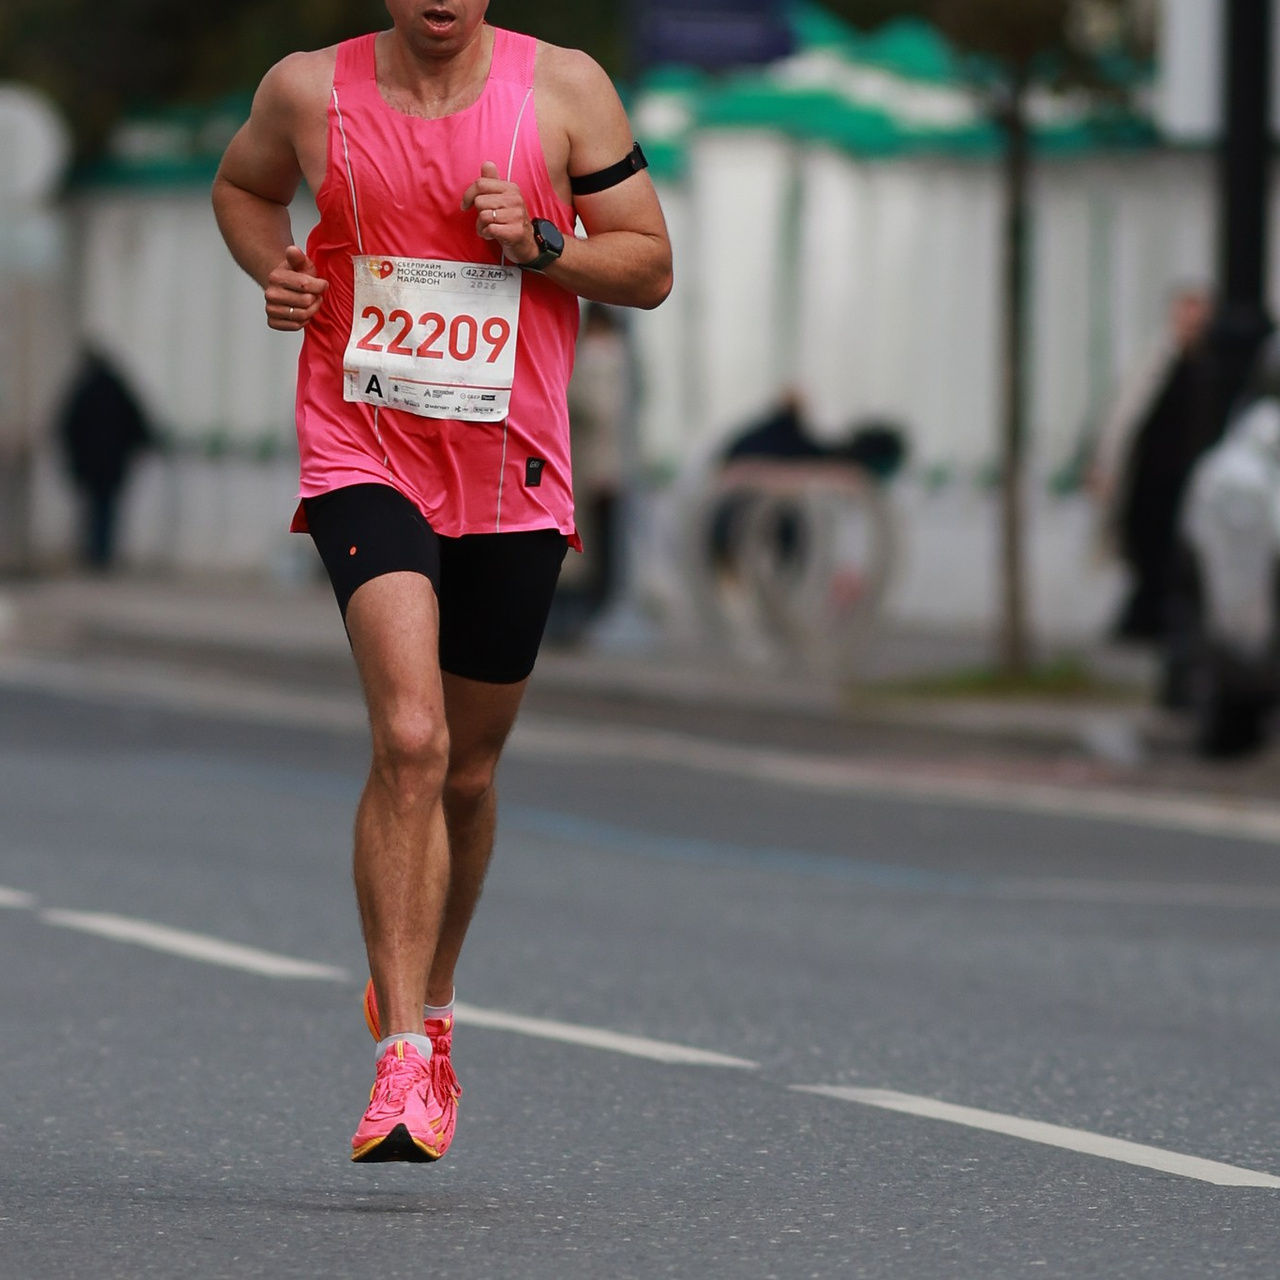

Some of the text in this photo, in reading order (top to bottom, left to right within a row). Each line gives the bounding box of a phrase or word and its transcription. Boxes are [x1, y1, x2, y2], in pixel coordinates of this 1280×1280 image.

[397, 261, 441, 270] СБЕРПРАЙМ
[397, 268, 456, 279] МОСКОВСКИЙ
[397, 275, 440, 286] МАРАФОН
[356, 305, 510, 363] 22209
